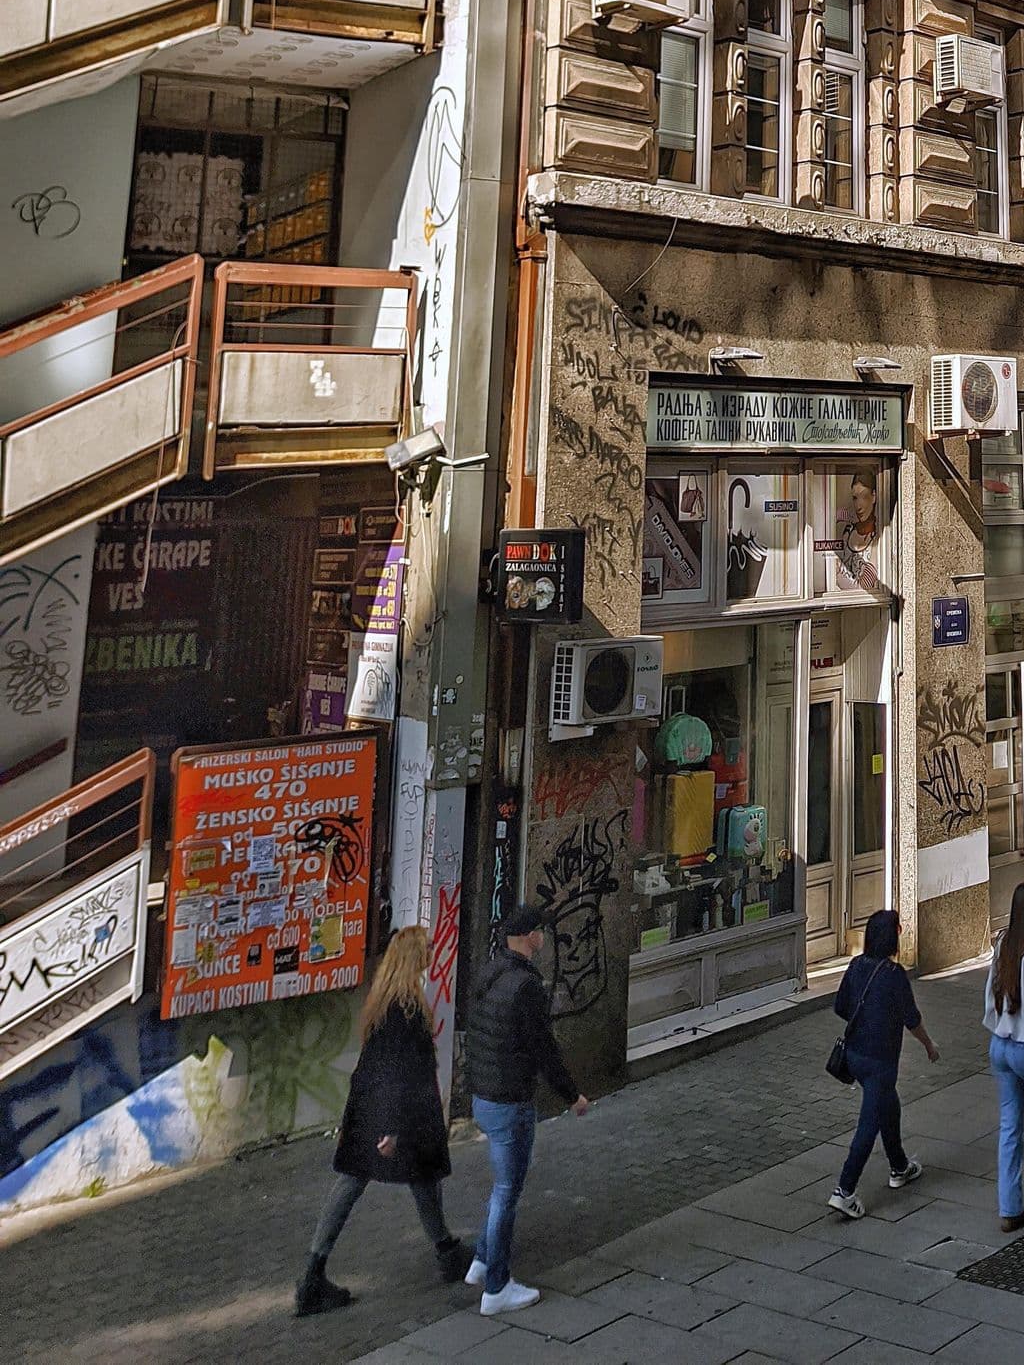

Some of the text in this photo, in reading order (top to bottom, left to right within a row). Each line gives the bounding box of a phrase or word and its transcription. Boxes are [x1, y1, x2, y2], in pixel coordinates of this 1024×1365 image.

[657, 392, 702, 416] РАДЊА
[722, 395, 767, 417] ИЗРАДУ
[772, 396, 813, 419] КОЖНЕ
[818, 398, 887, 423] ГАЛАНТЕРИЈЕ
[656, 417, 702, 441] КОФЕРА
[706, 420, 741, 442] ТАШНИ
[746, 420, 797, 443] РУКАВИЦА
[506, 542, 557, 563] PAWN DOK
[505, 562, 557, 572] ZALAGAONICA
[255, 748, 289, 764] SALON
[204, 759, 356, 790] MUŠKO ŠIŠANJE
[254, 780, 307, 800] 470
[195, 795, 360, 830] ŽENSKO ŠIŠANJE
[303, 899, 363, 919] MODELA
[219, 980, 269, 1010] KOSTIMI
[314, 971, 328, 991] do
[331, 965, 359, 989] 2000
